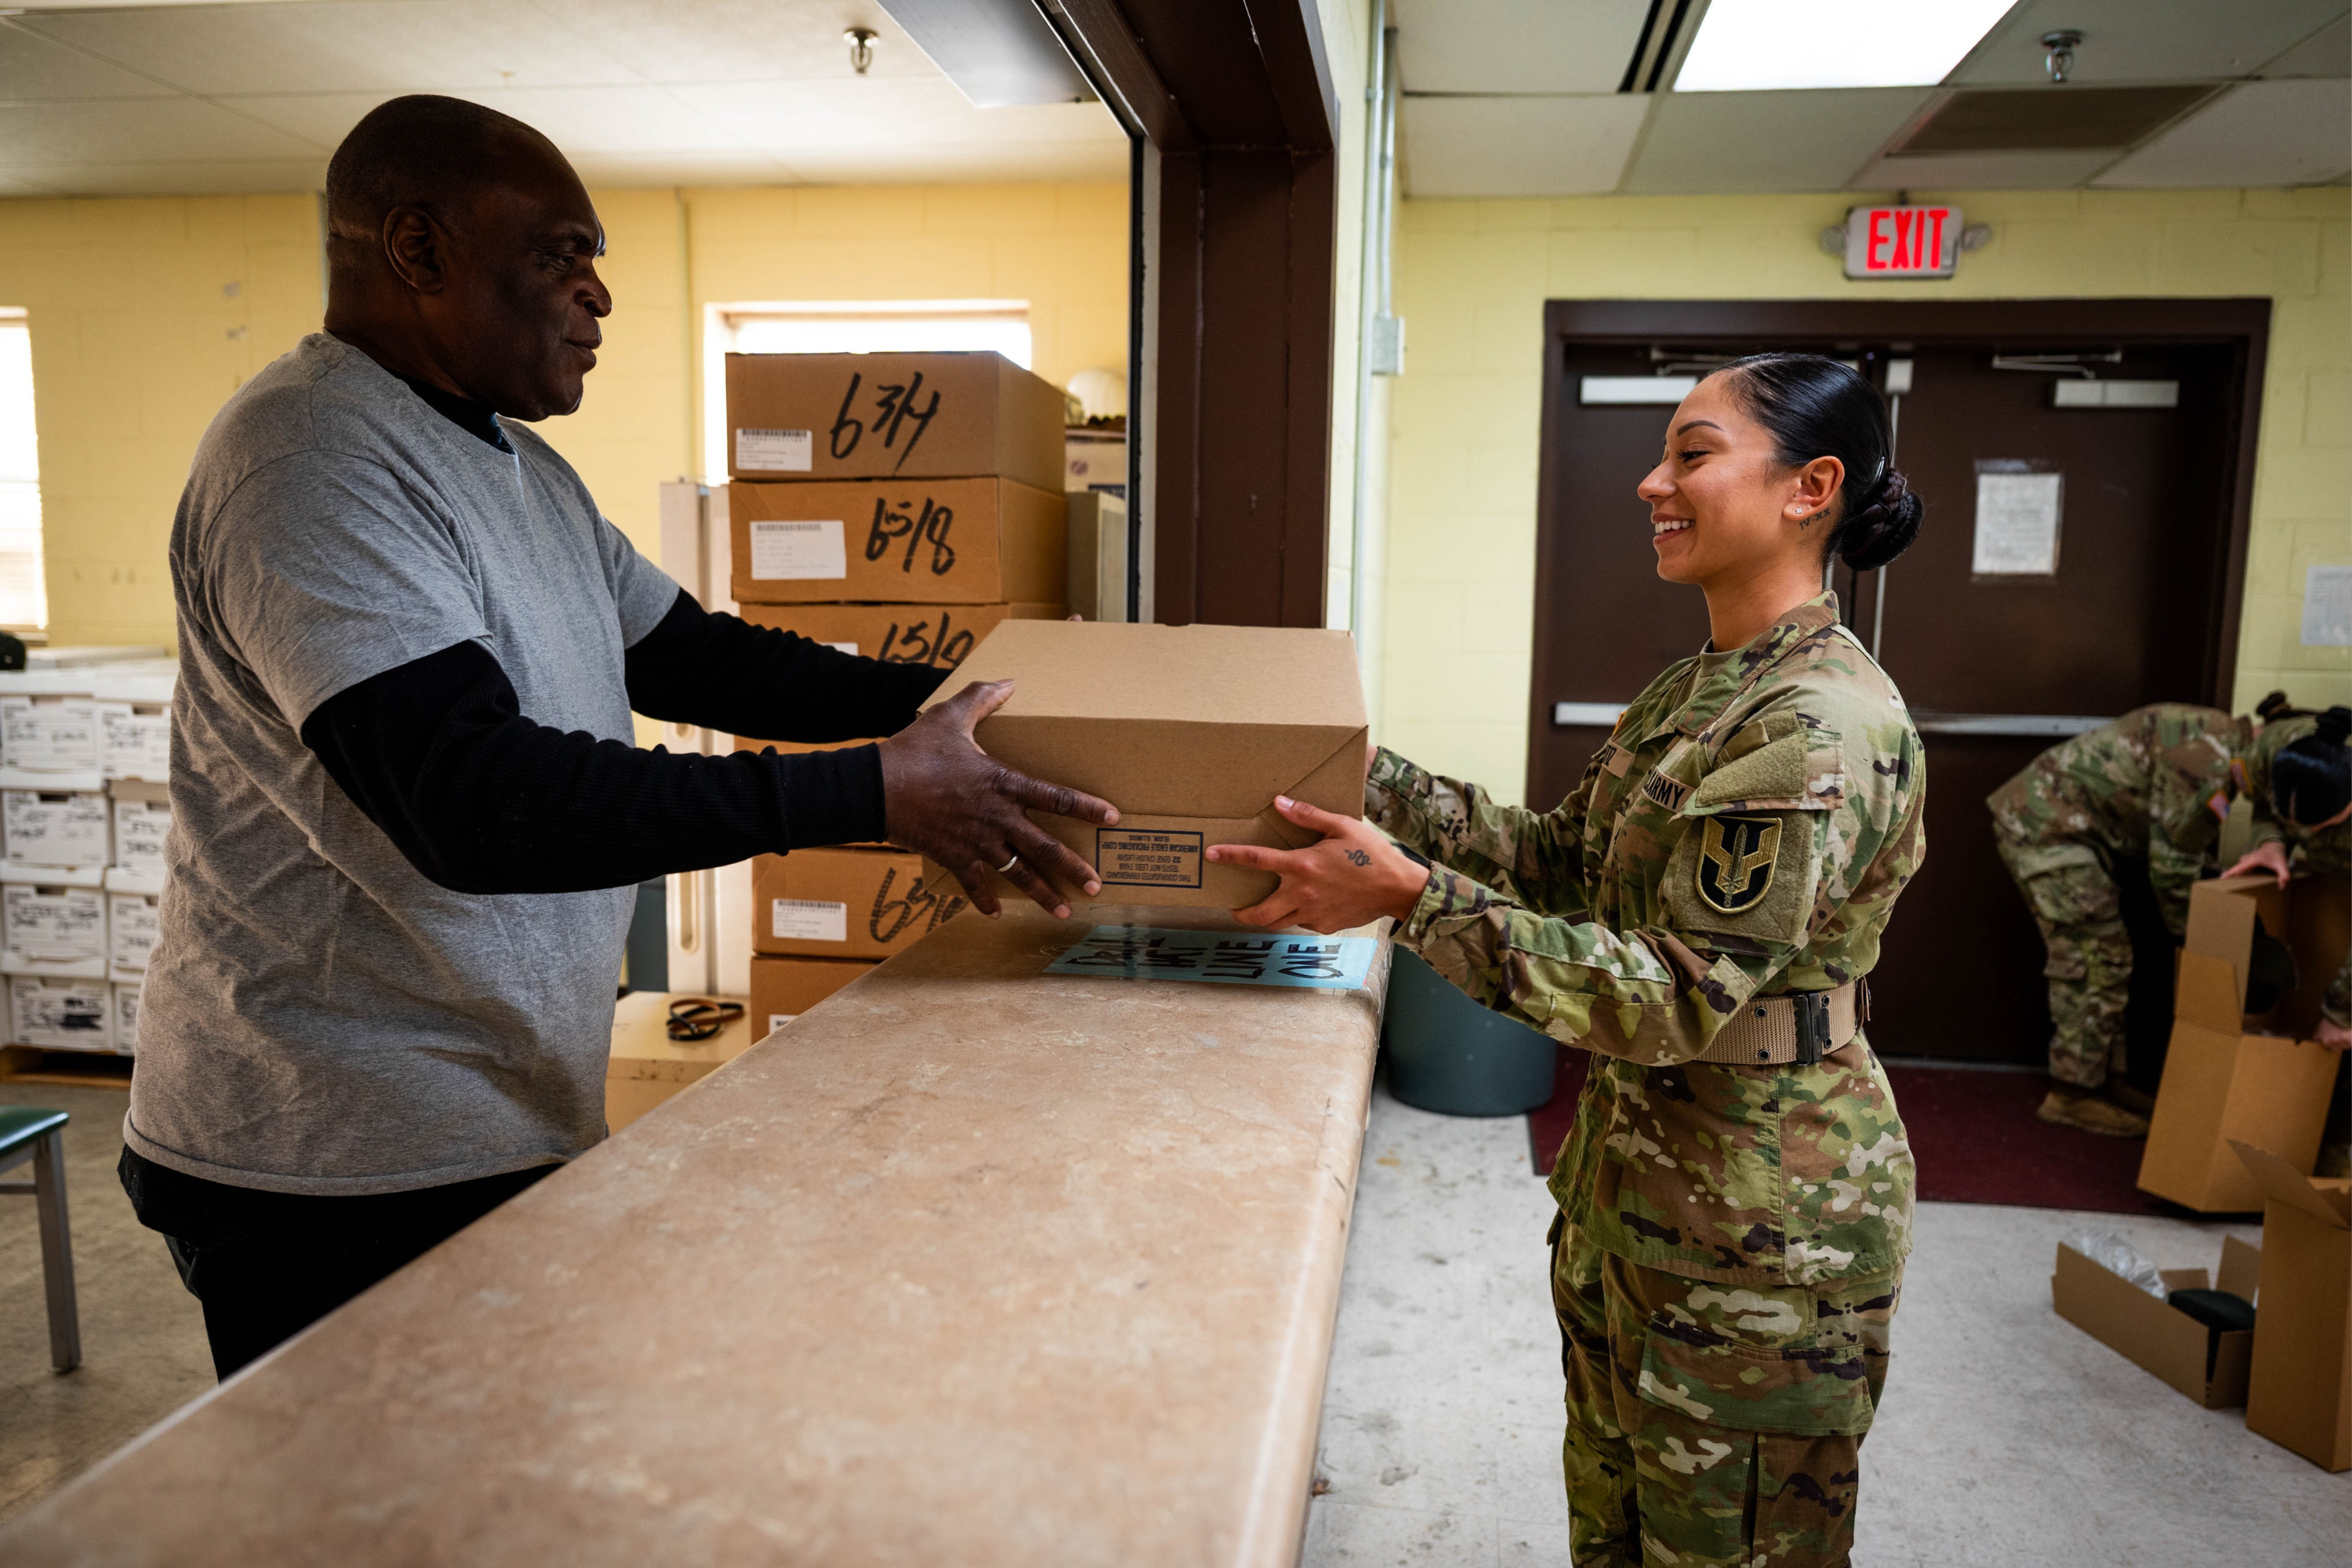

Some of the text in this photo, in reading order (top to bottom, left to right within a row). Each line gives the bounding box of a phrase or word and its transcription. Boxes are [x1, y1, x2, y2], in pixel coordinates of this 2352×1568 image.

[1867, 209, 1949, 270] EXIT
[1646, 773, 1686, 810] ARMY
[1118, 841, 1150, 851] PACKAGING
[1150, 843, 1168, 851] EAGLE
[1169, 844, 1199, 853] AMERICAN
[1136, 854, 1156, 862] CRUSH
[1142, 873, 1178, 882] CORRUGATED
[1201, 940, 1279, 979] LINE
[1277, 942, 1345, 979] ONE
